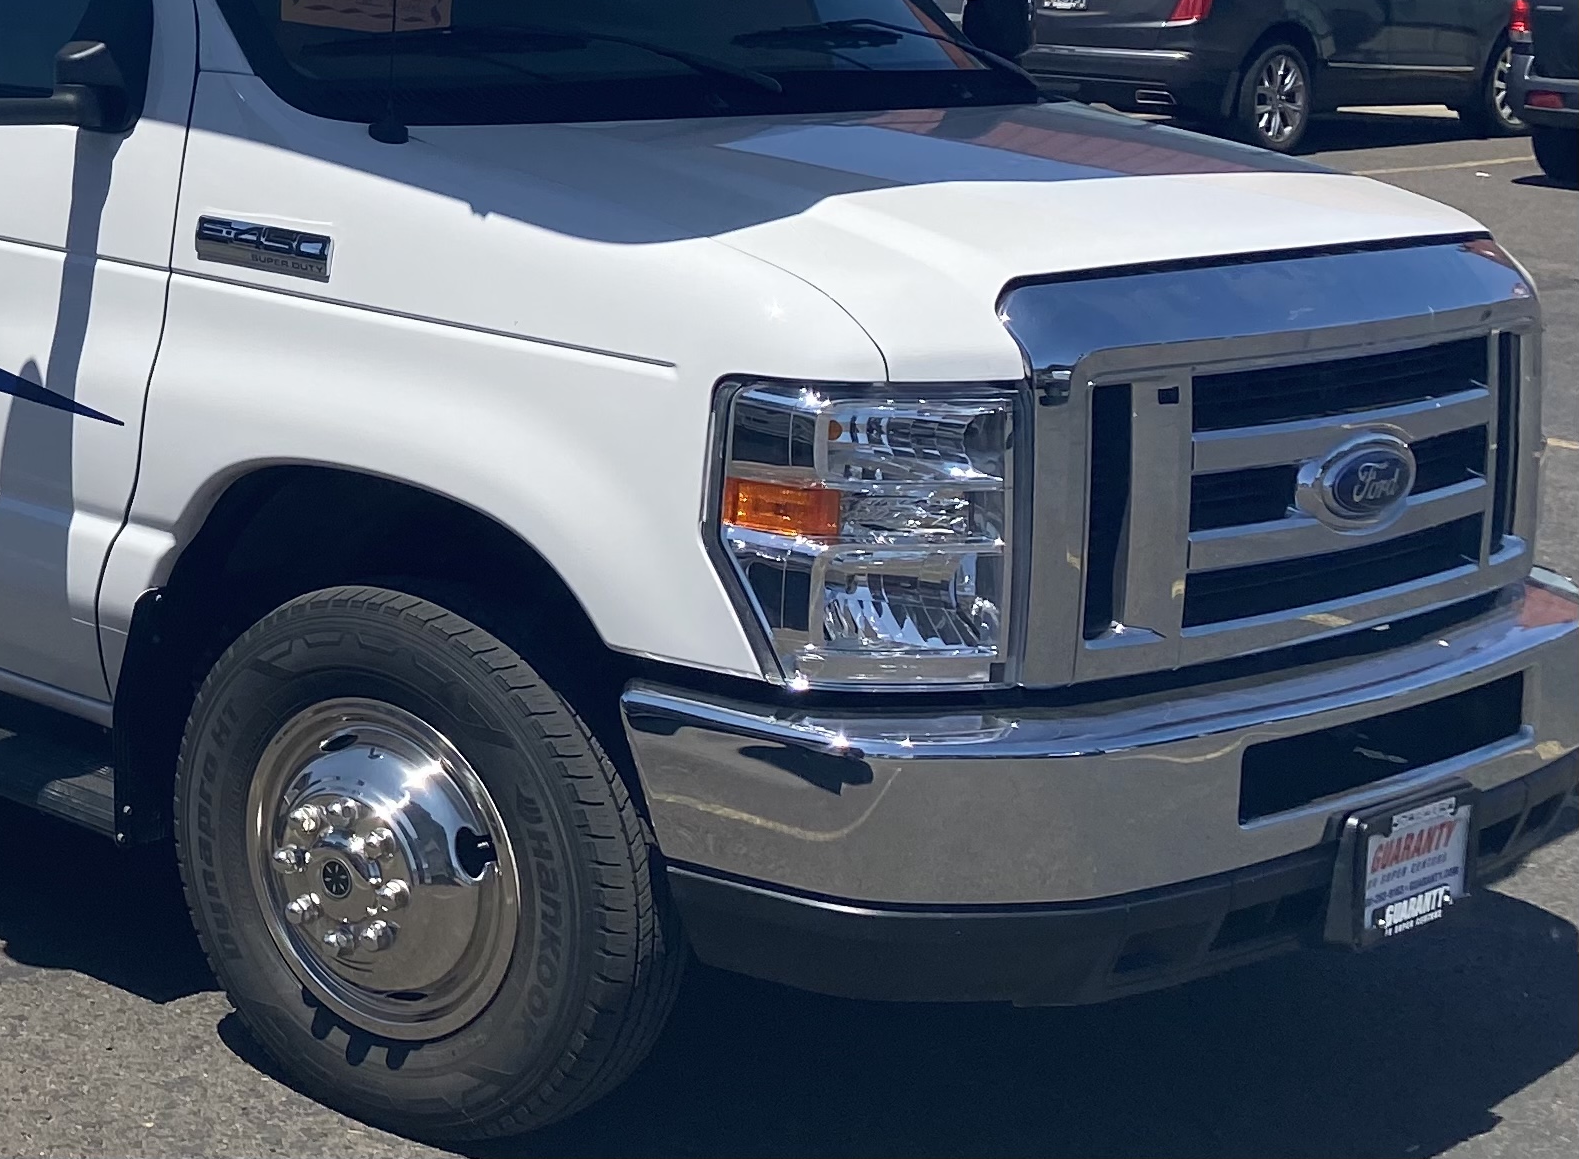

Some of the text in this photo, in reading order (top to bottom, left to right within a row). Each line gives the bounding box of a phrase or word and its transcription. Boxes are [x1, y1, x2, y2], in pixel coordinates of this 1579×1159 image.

[251, 253, 324, 274] SUPER DUTY
[1352, 462, 1400, 502] Ford
[1370, 819, 1458, 874] GUARANTY
[1384, 885, 1451, 930] GUARANTY
